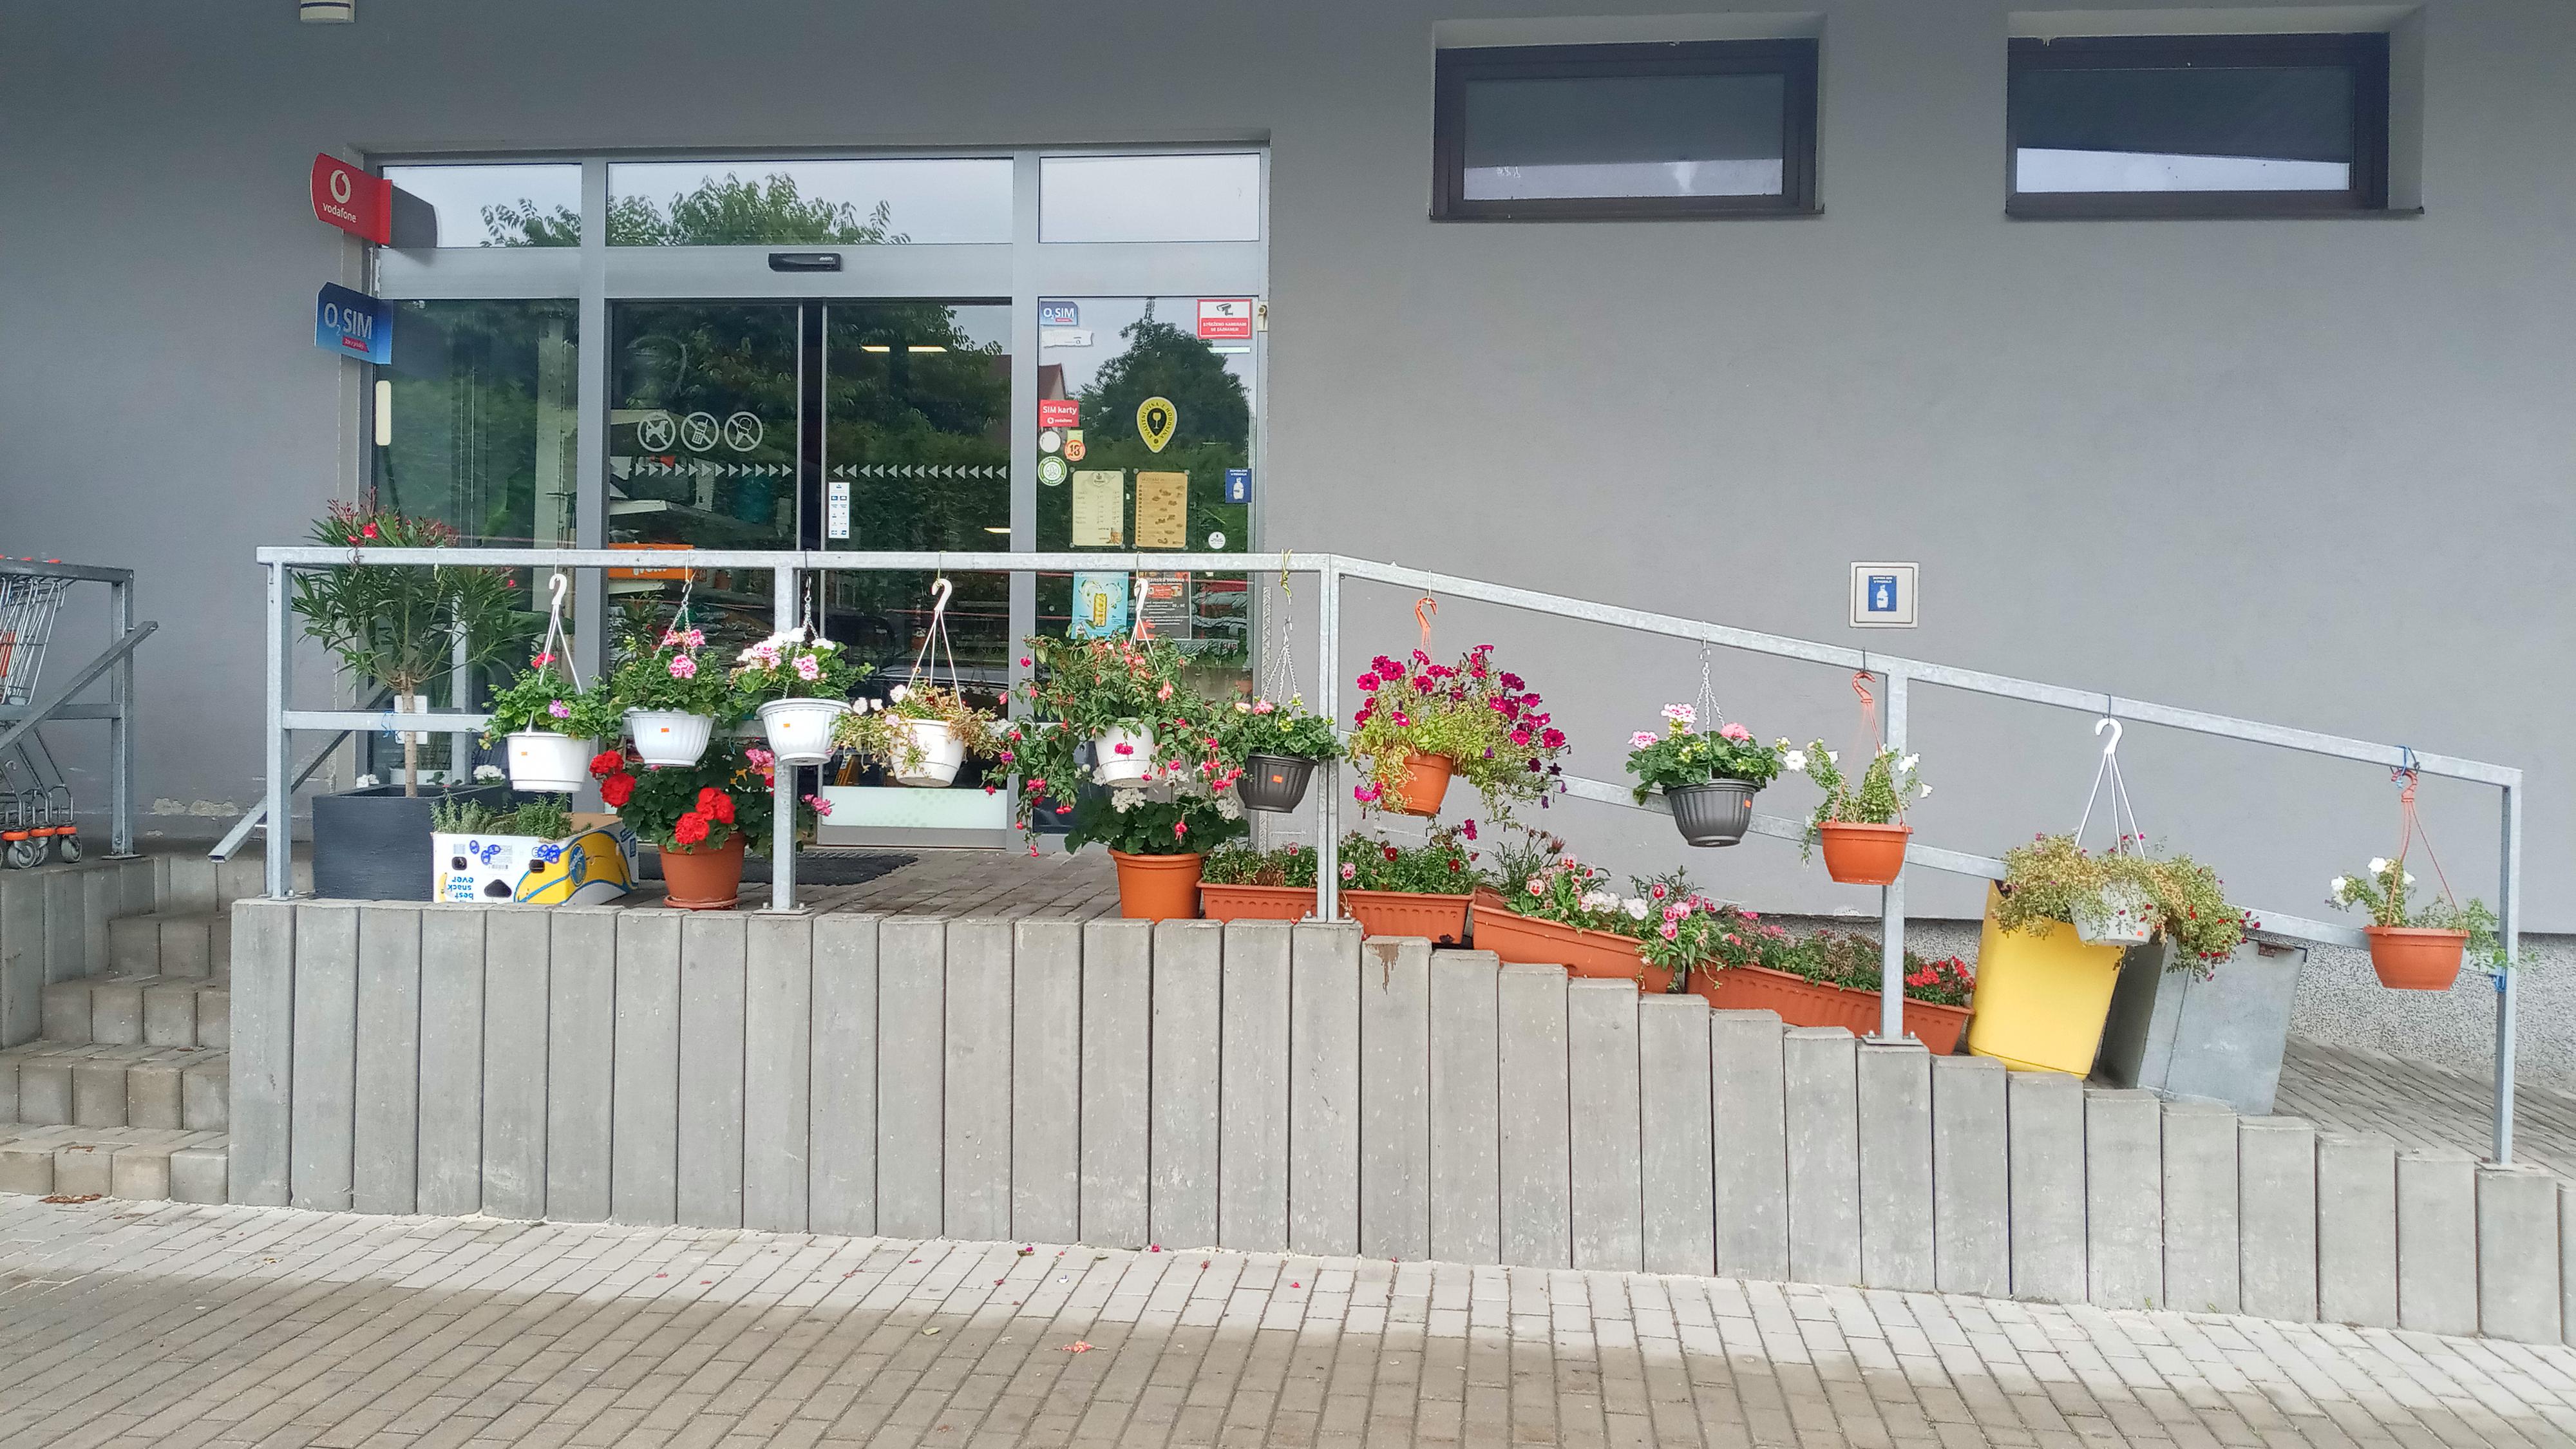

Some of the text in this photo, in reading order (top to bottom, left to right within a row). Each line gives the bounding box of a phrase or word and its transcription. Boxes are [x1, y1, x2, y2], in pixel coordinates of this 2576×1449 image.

[323, 203, 356, 223] vodafone
[1055, 308, 1074, 317] SIM
[343, 308, 372, 339] SIM
[1057, 406, 1077, 415] karty
[1070, 444, 1080, 456] 18
